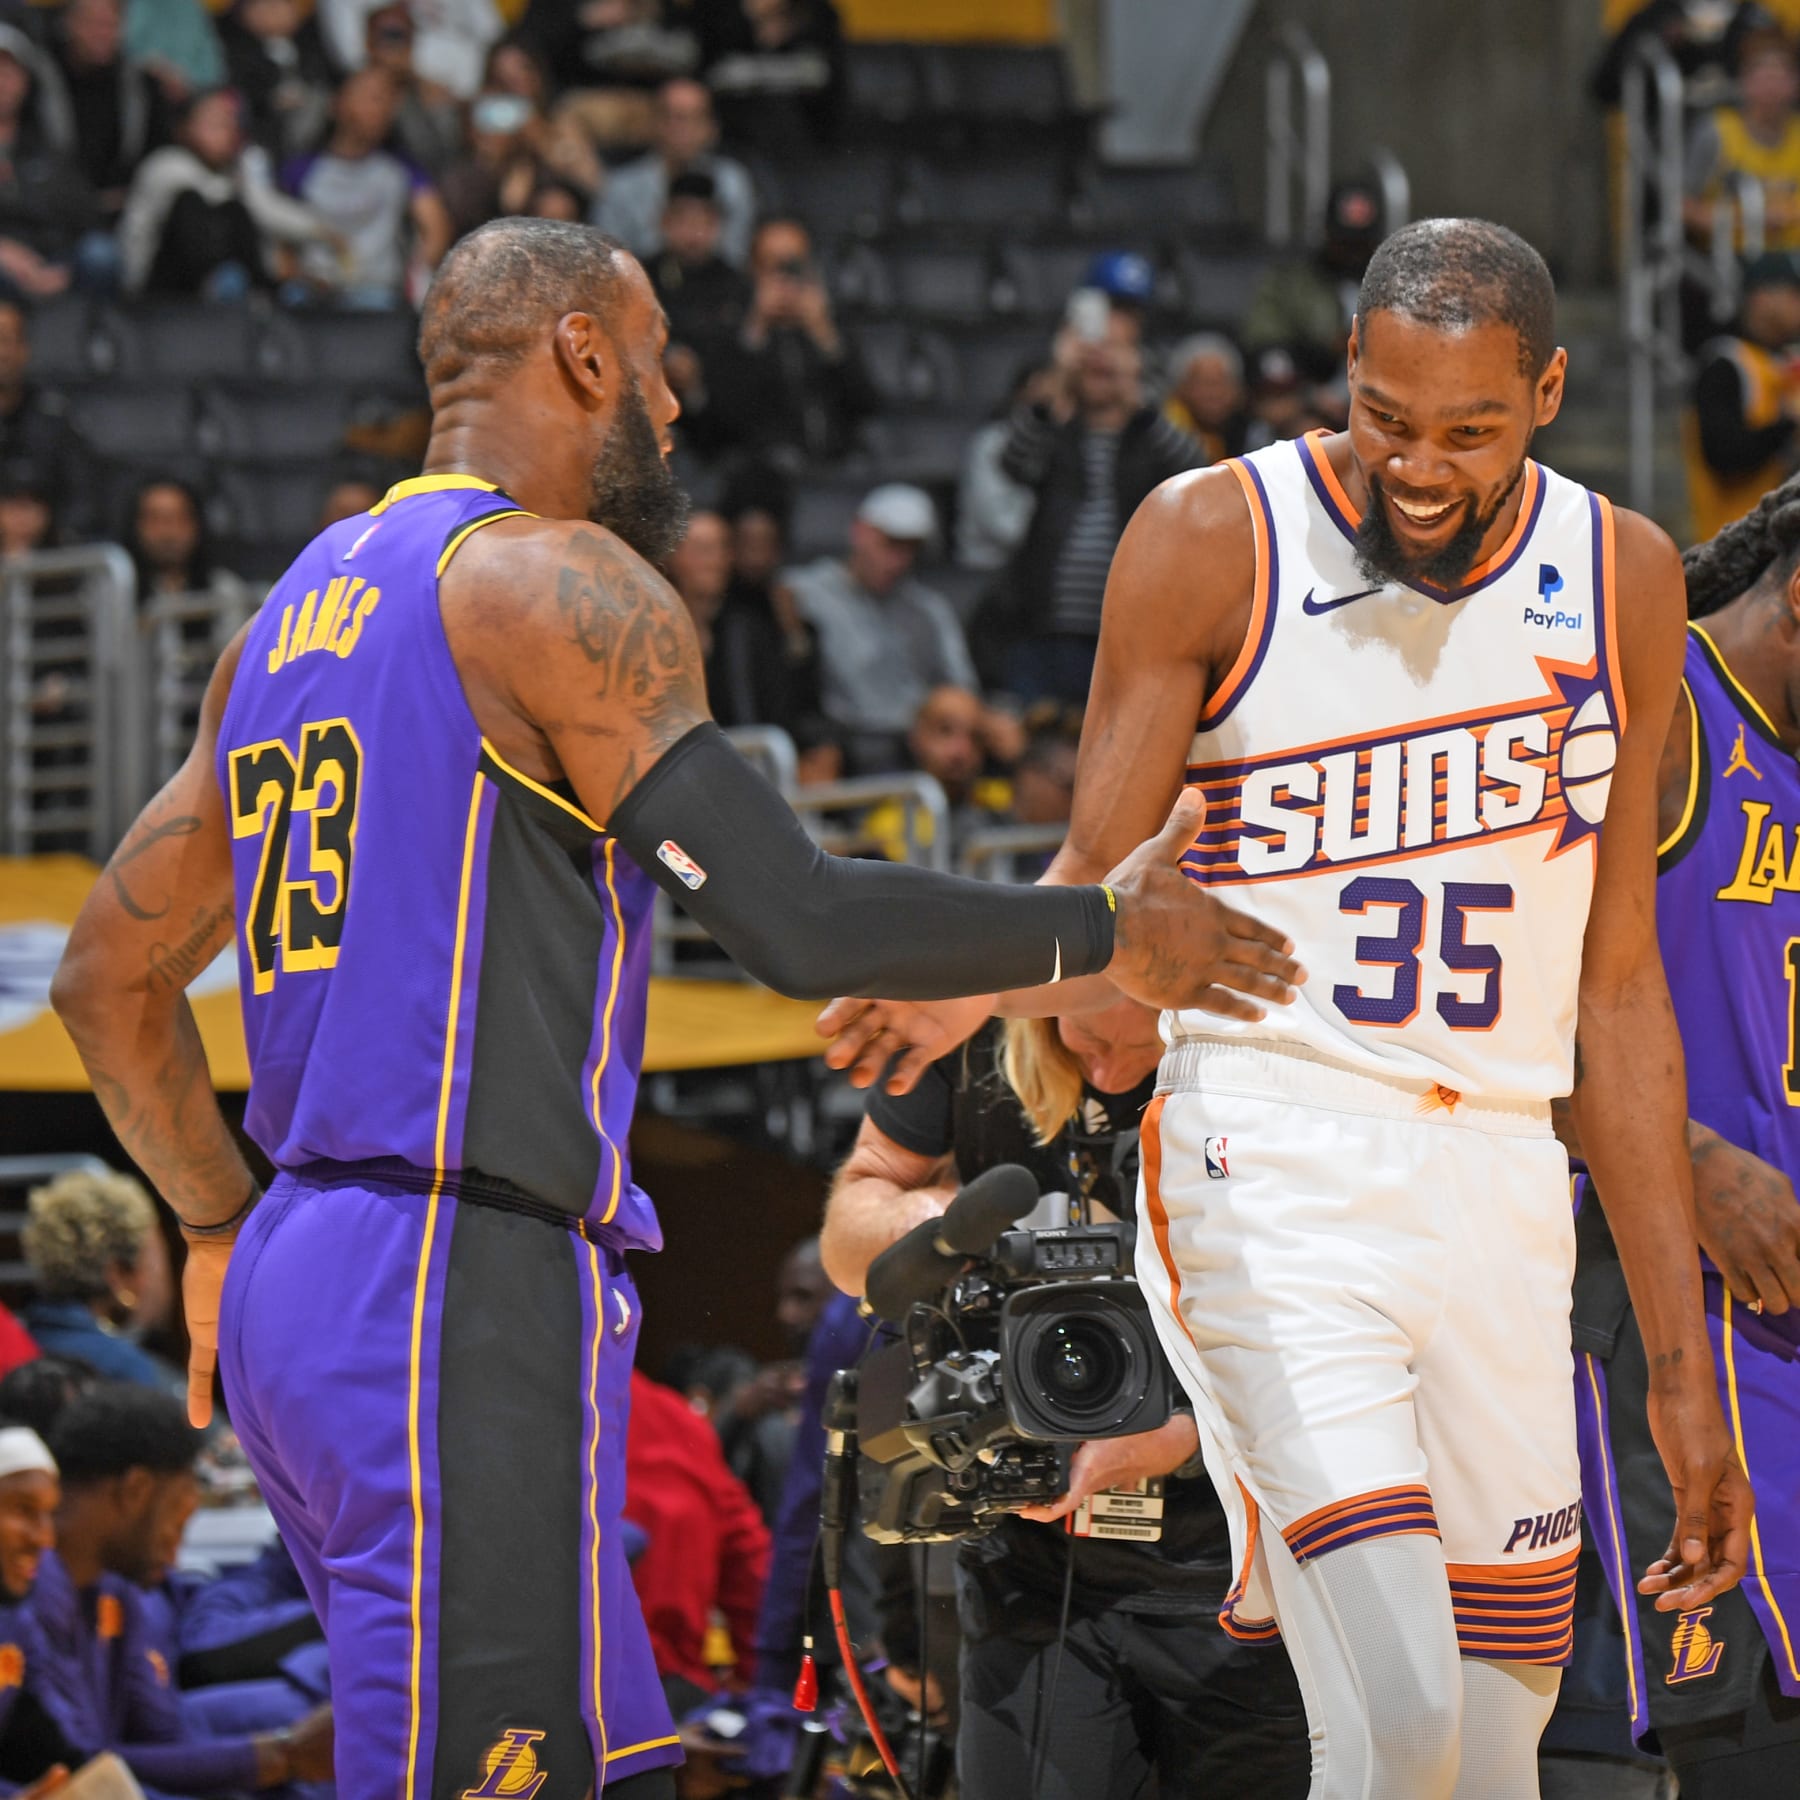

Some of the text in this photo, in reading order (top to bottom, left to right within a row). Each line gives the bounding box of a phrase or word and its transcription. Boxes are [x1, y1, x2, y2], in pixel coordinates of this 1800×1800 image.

[267, 576, 381, 674] JAMES
[1523, 607, 1582, 630] PayPal
[1238, 714, 1550, 876] SUNS
[1715, 799, 1800, 905] LA
[1332, 875, 1515, 1032] 35
[1035, 1230, 1068, 1238] SONY
